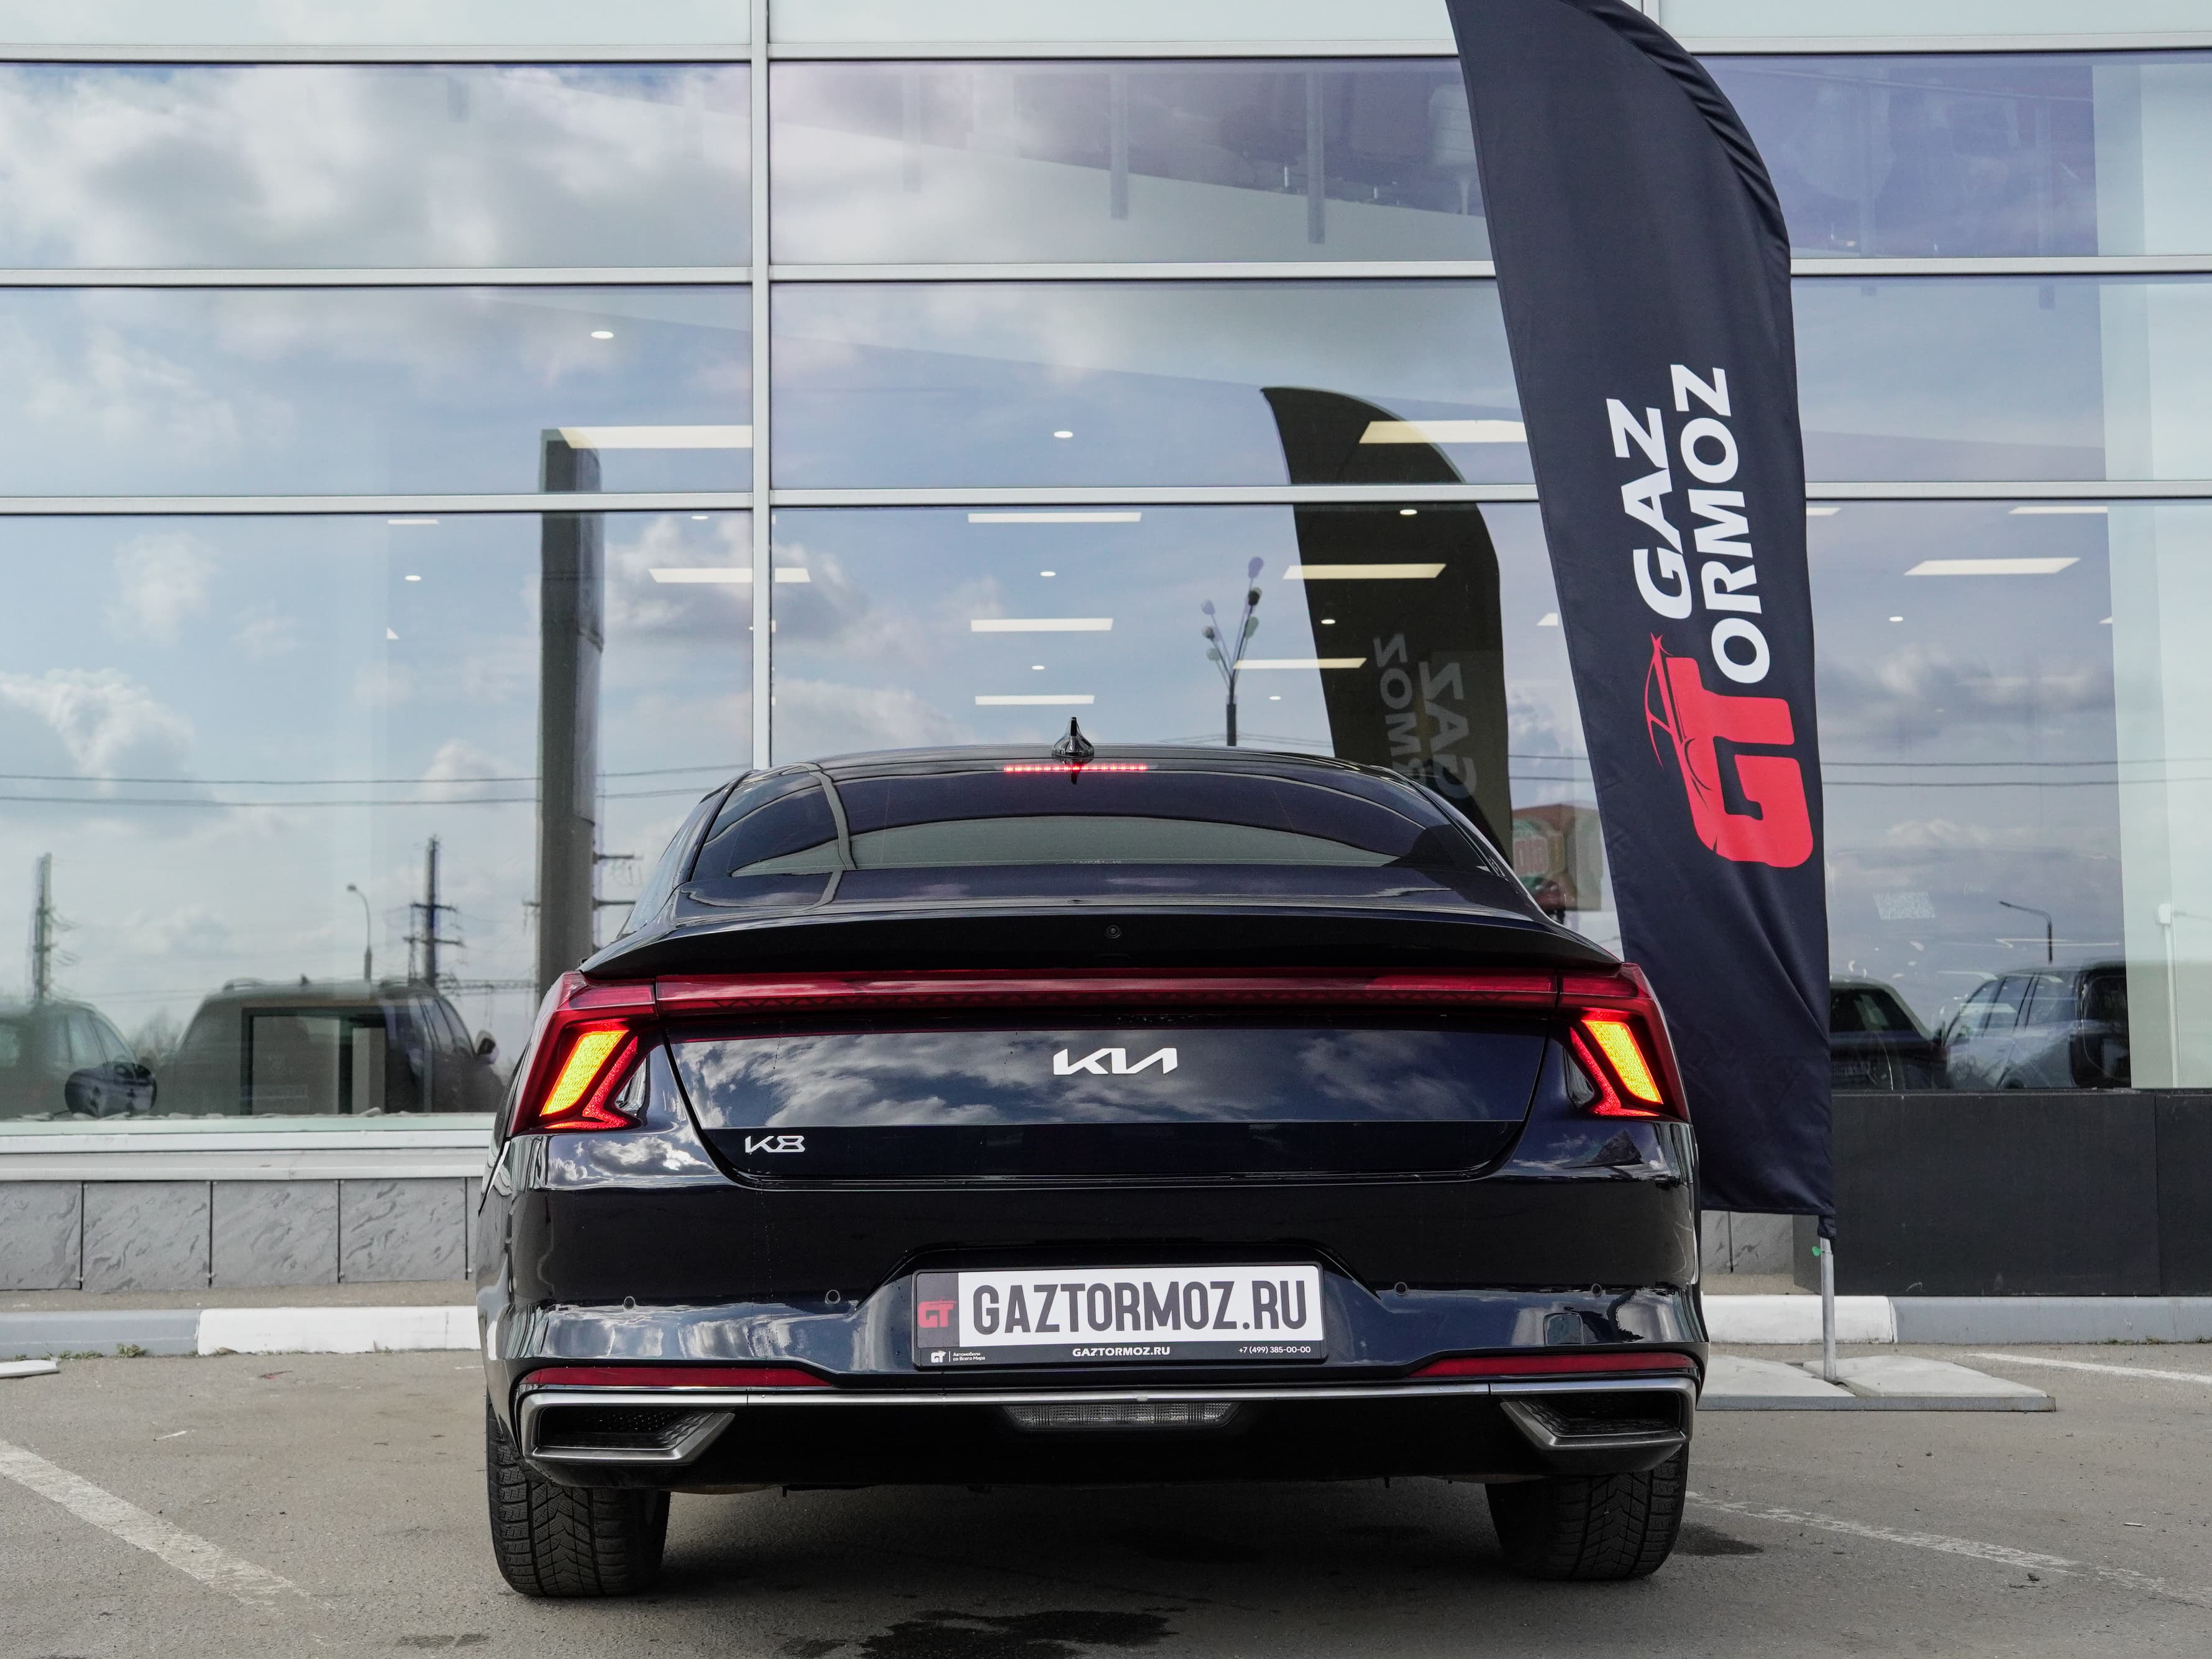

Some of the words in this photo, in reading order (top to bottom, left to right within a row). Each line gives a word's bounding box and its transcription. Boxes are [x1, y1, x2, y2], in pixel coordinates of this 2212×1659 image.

[1606, 398, 1693, 620] GAZ
[1654, 646, 1814, 869] GT
[1053, 1047, 1178, 1076] KIA
[744, 1135, 807, 1153] K8
[917, 1299, 955, 1328] GT
[972, 1280, 1307, 1335] GAZTORMOZ.RU
[1072, 1346, 1171, 1357] GAZTORMOZ.RU
[1249, 1346, 1269, 1354] (499)
